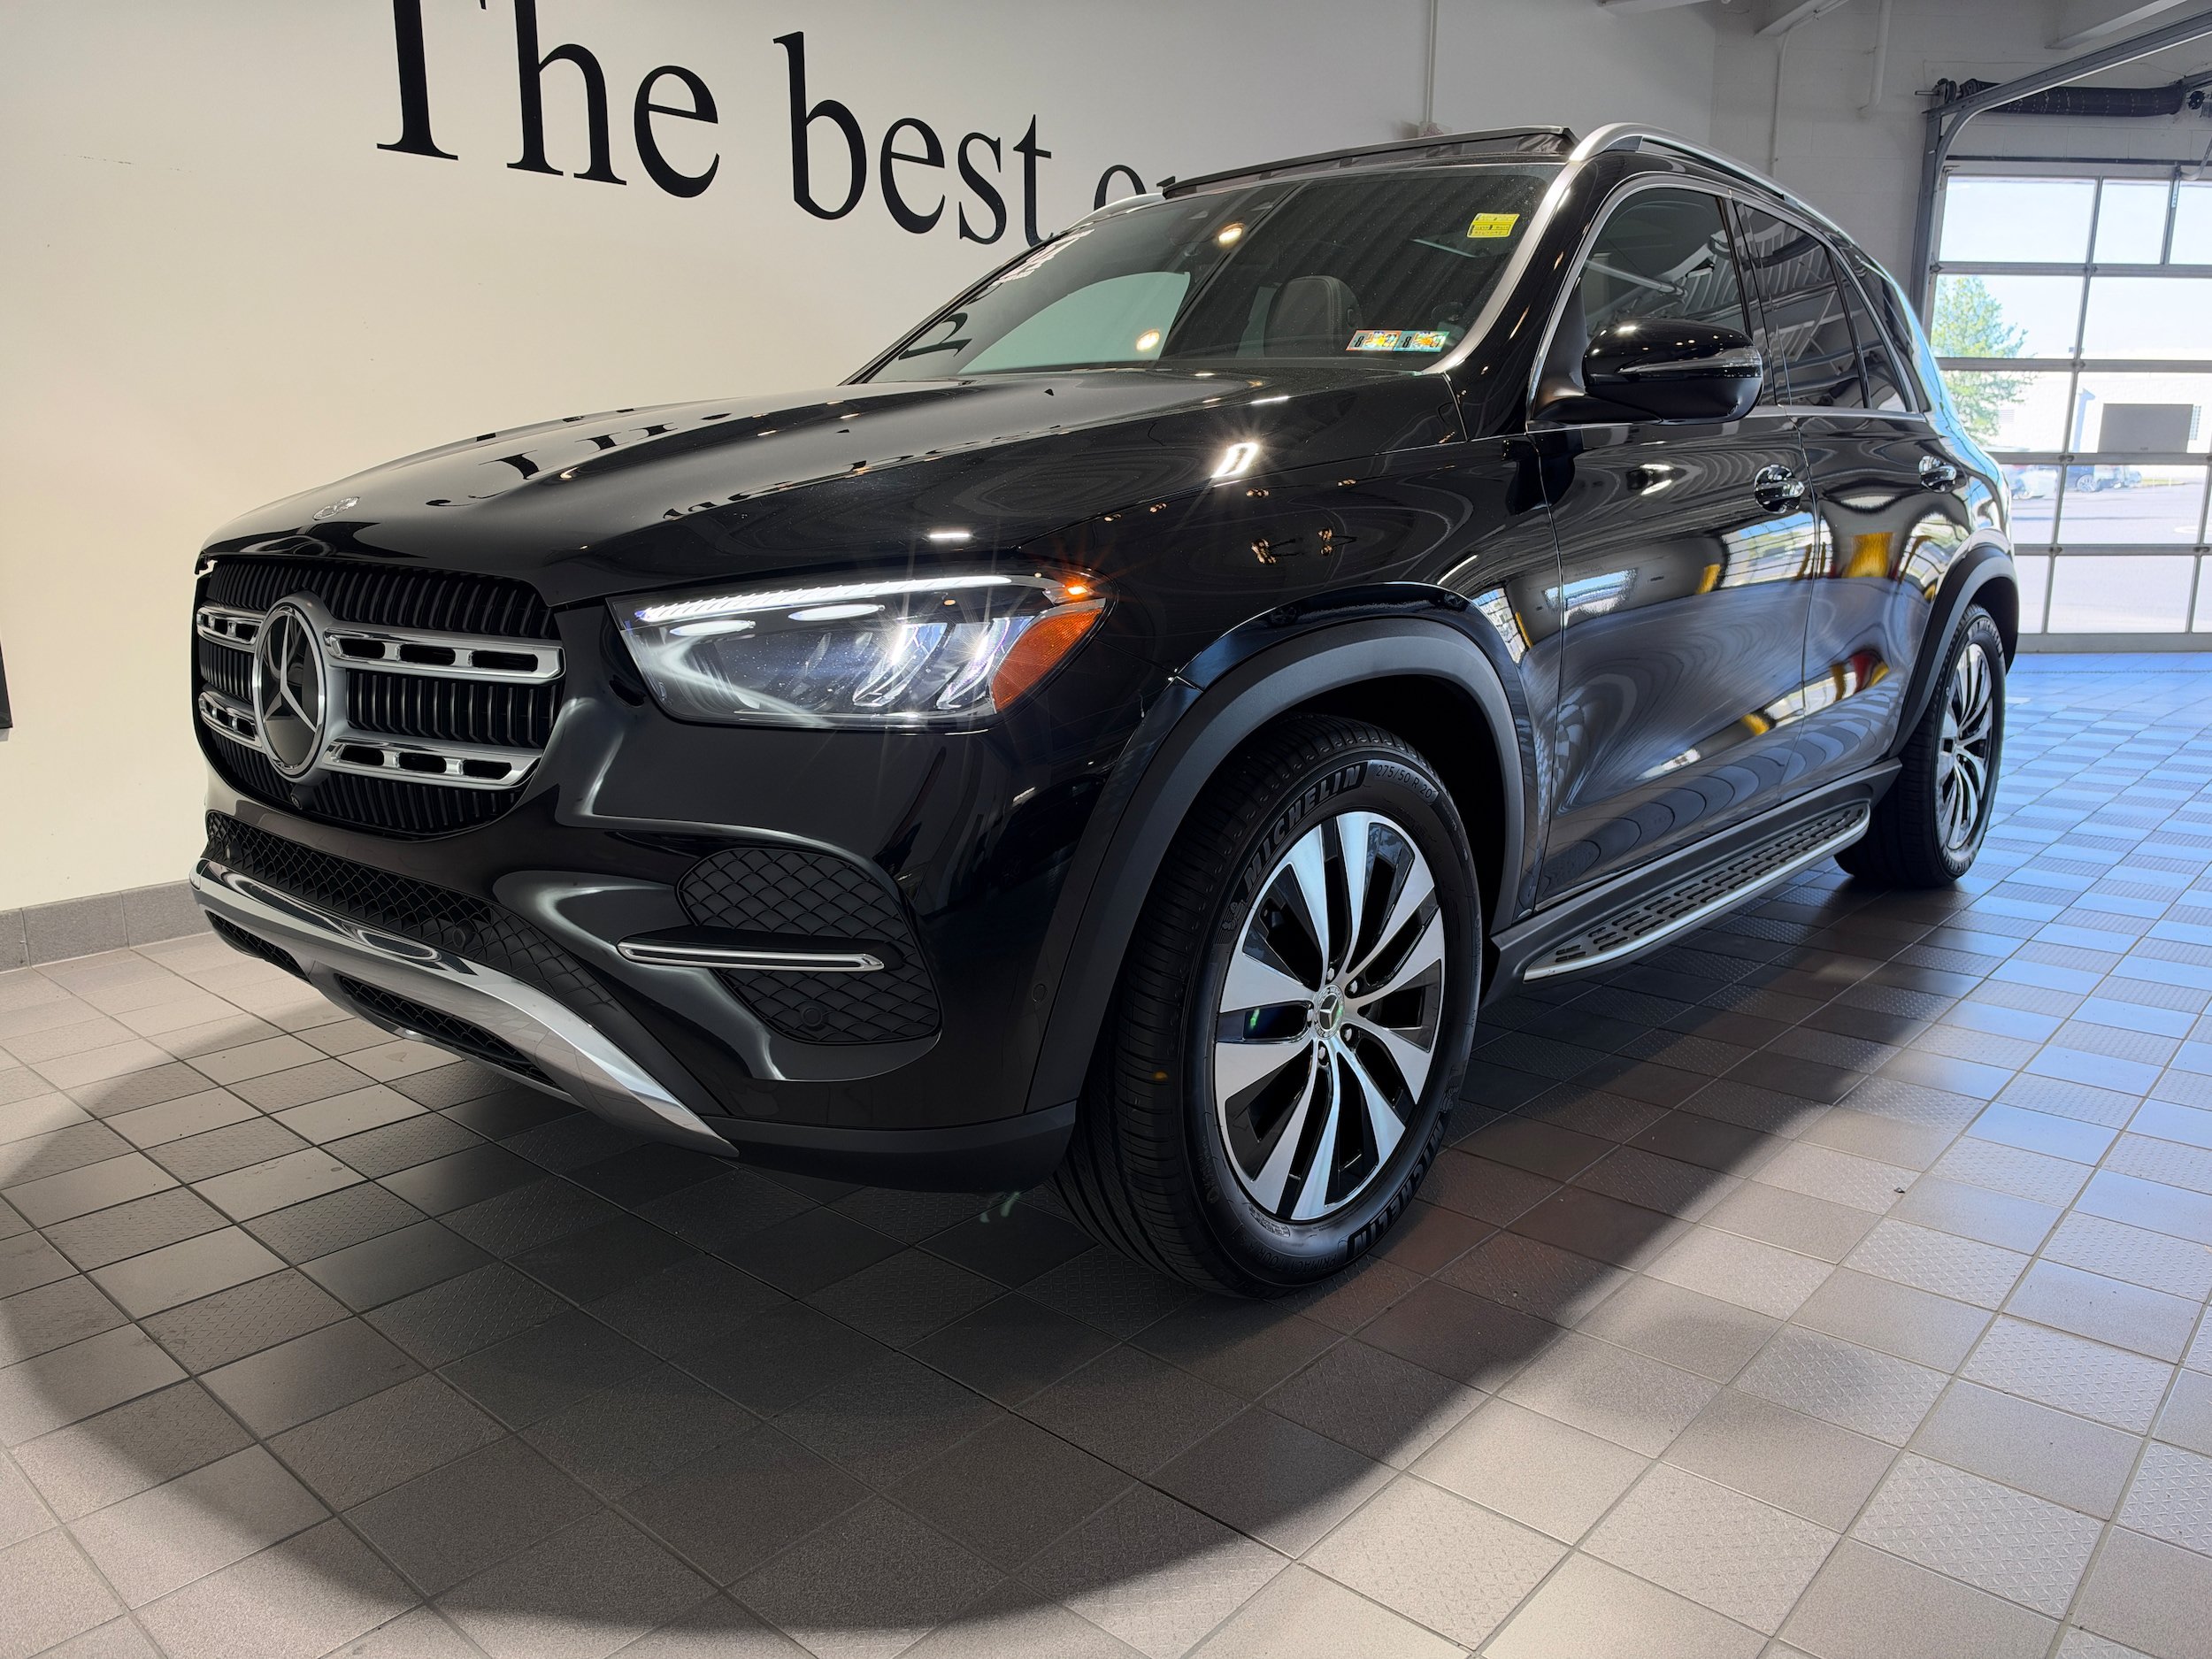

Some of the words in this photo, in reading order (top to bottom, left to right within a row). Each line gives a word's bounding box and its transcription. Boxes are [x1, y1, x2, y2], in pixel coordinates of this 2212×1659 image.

[377, 0, 720, 198] The
[772, 31, 1053, 248] best
[1243, 764, 1362, 894] MICHELIN
[1376, 764, 1411, 784] 275/50
[1411, 776, 1420, 790] R
[1419, 784, 1433, 800] 20
[1353, 1116, 1447, 1256] MICHELIN
